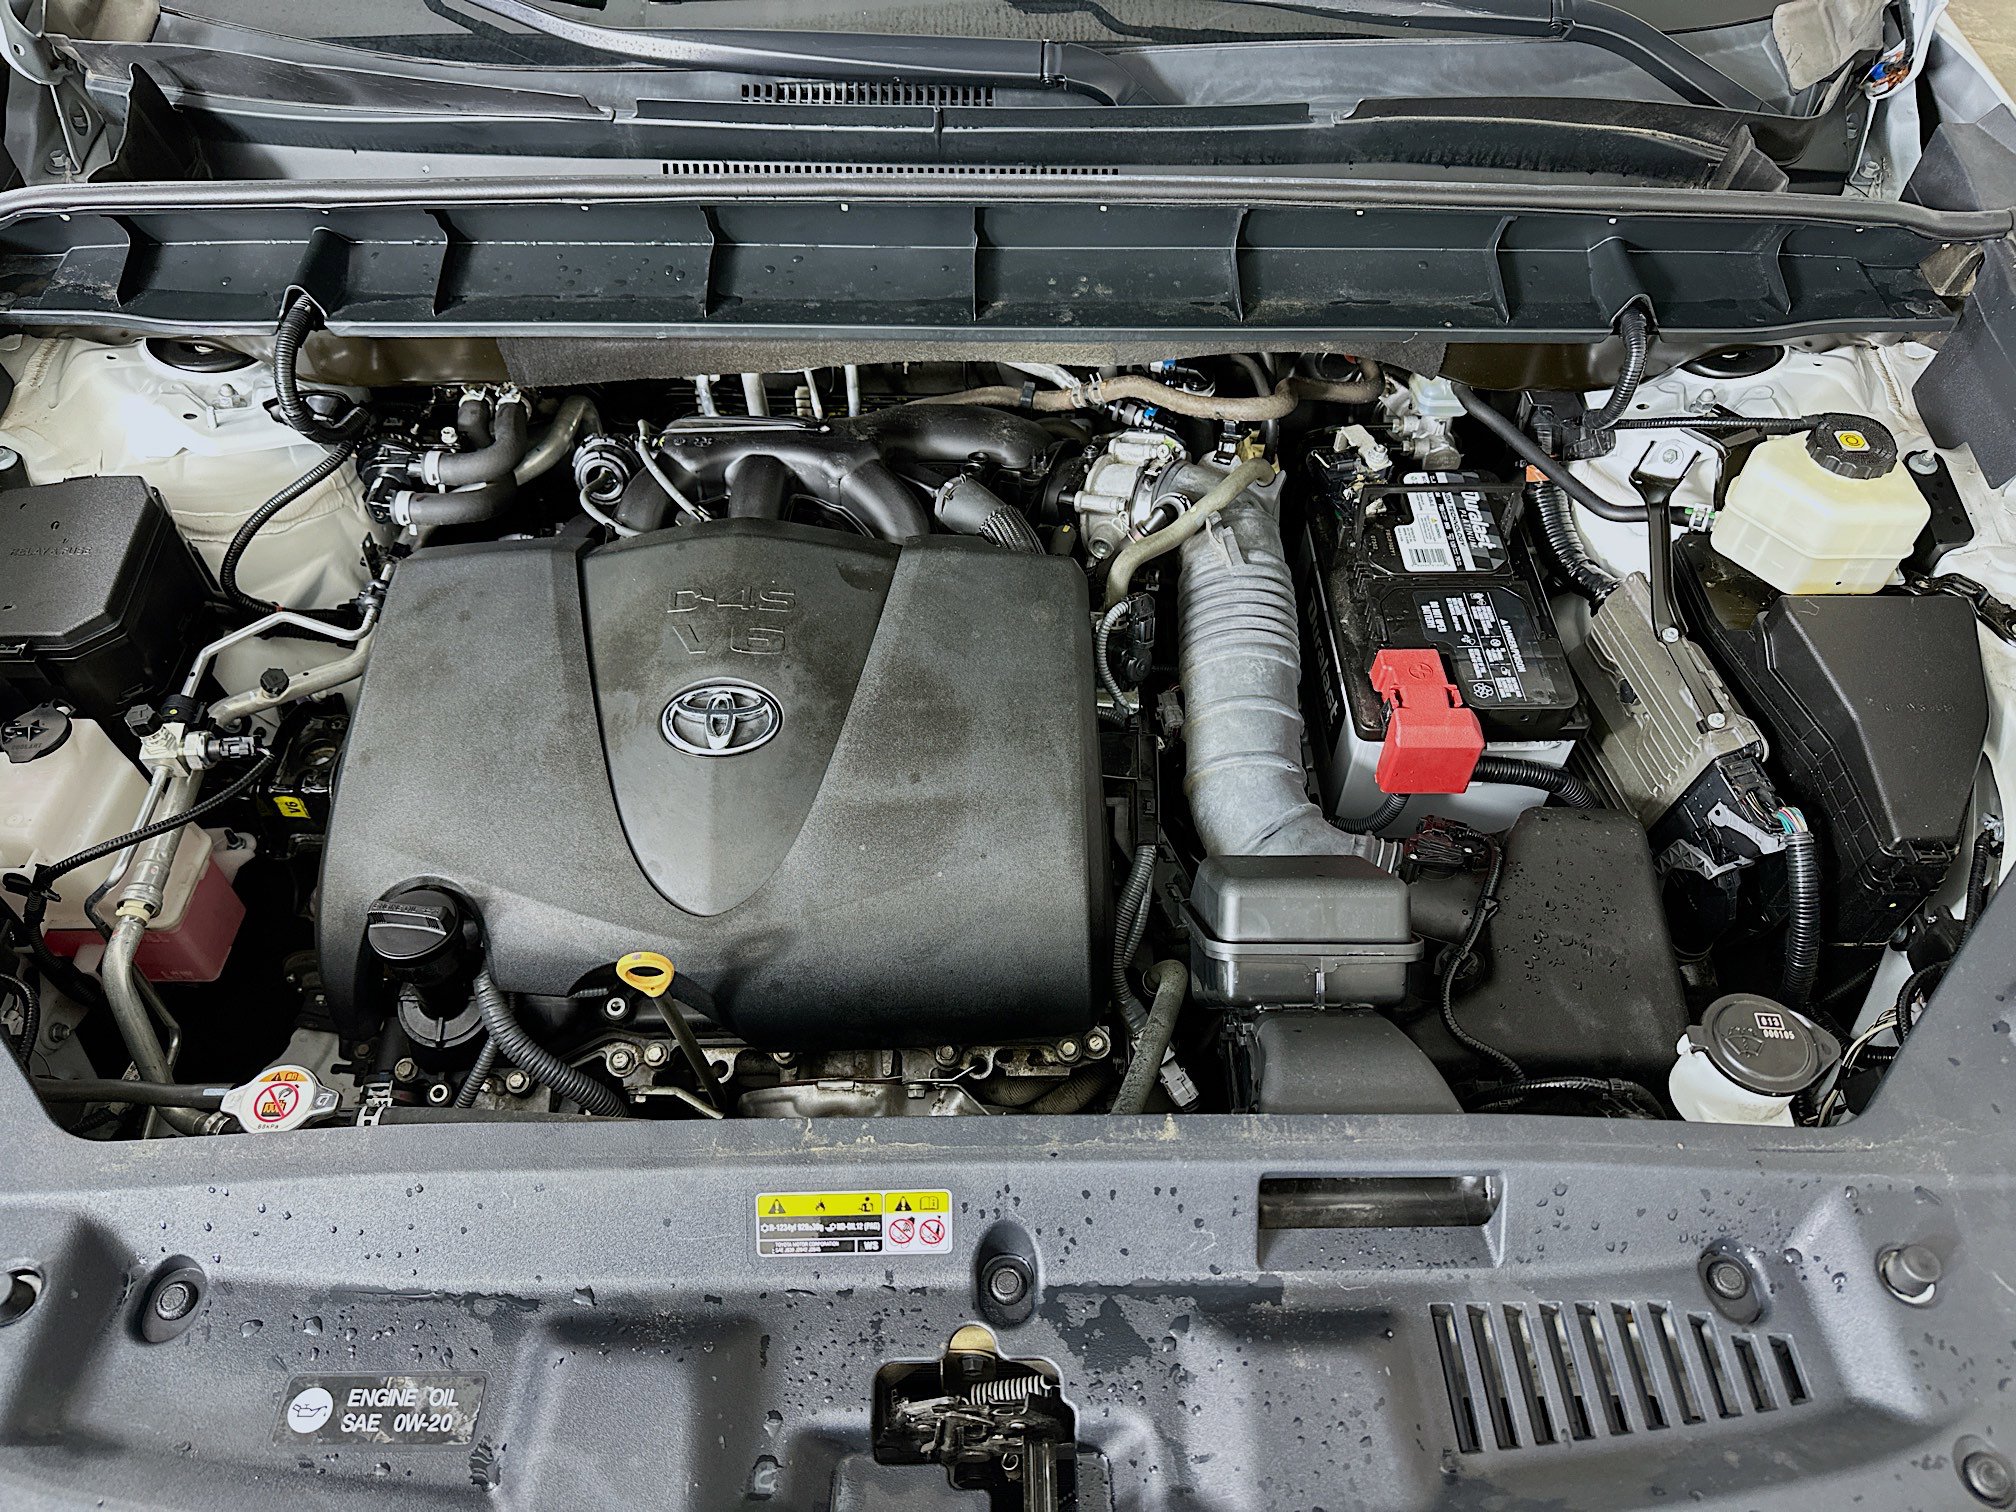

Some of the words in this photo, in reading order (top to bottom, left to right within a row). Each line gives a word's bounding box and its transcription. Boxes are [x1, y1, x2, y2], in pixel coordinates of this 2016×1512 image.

[1448, 505, 1466, 547] TECHNOLOGY
[1459, 509, 1478, 549] PLATINUM
[1460, 492, 1497, 550] Duralast
[672, 623, 786, 655] V6
[1307, 587, 1339, 725] Duralast
[285, 801, 301, 815] V6
[863, 1241, 879, 1251] WS
[347, 1388, 419, 1407] ENGINE
[429, 1388, 459, 1407] OIL
[340, 1413, 383, 1433] SAE
[393, 1413, 453, 1433] 0W-20
